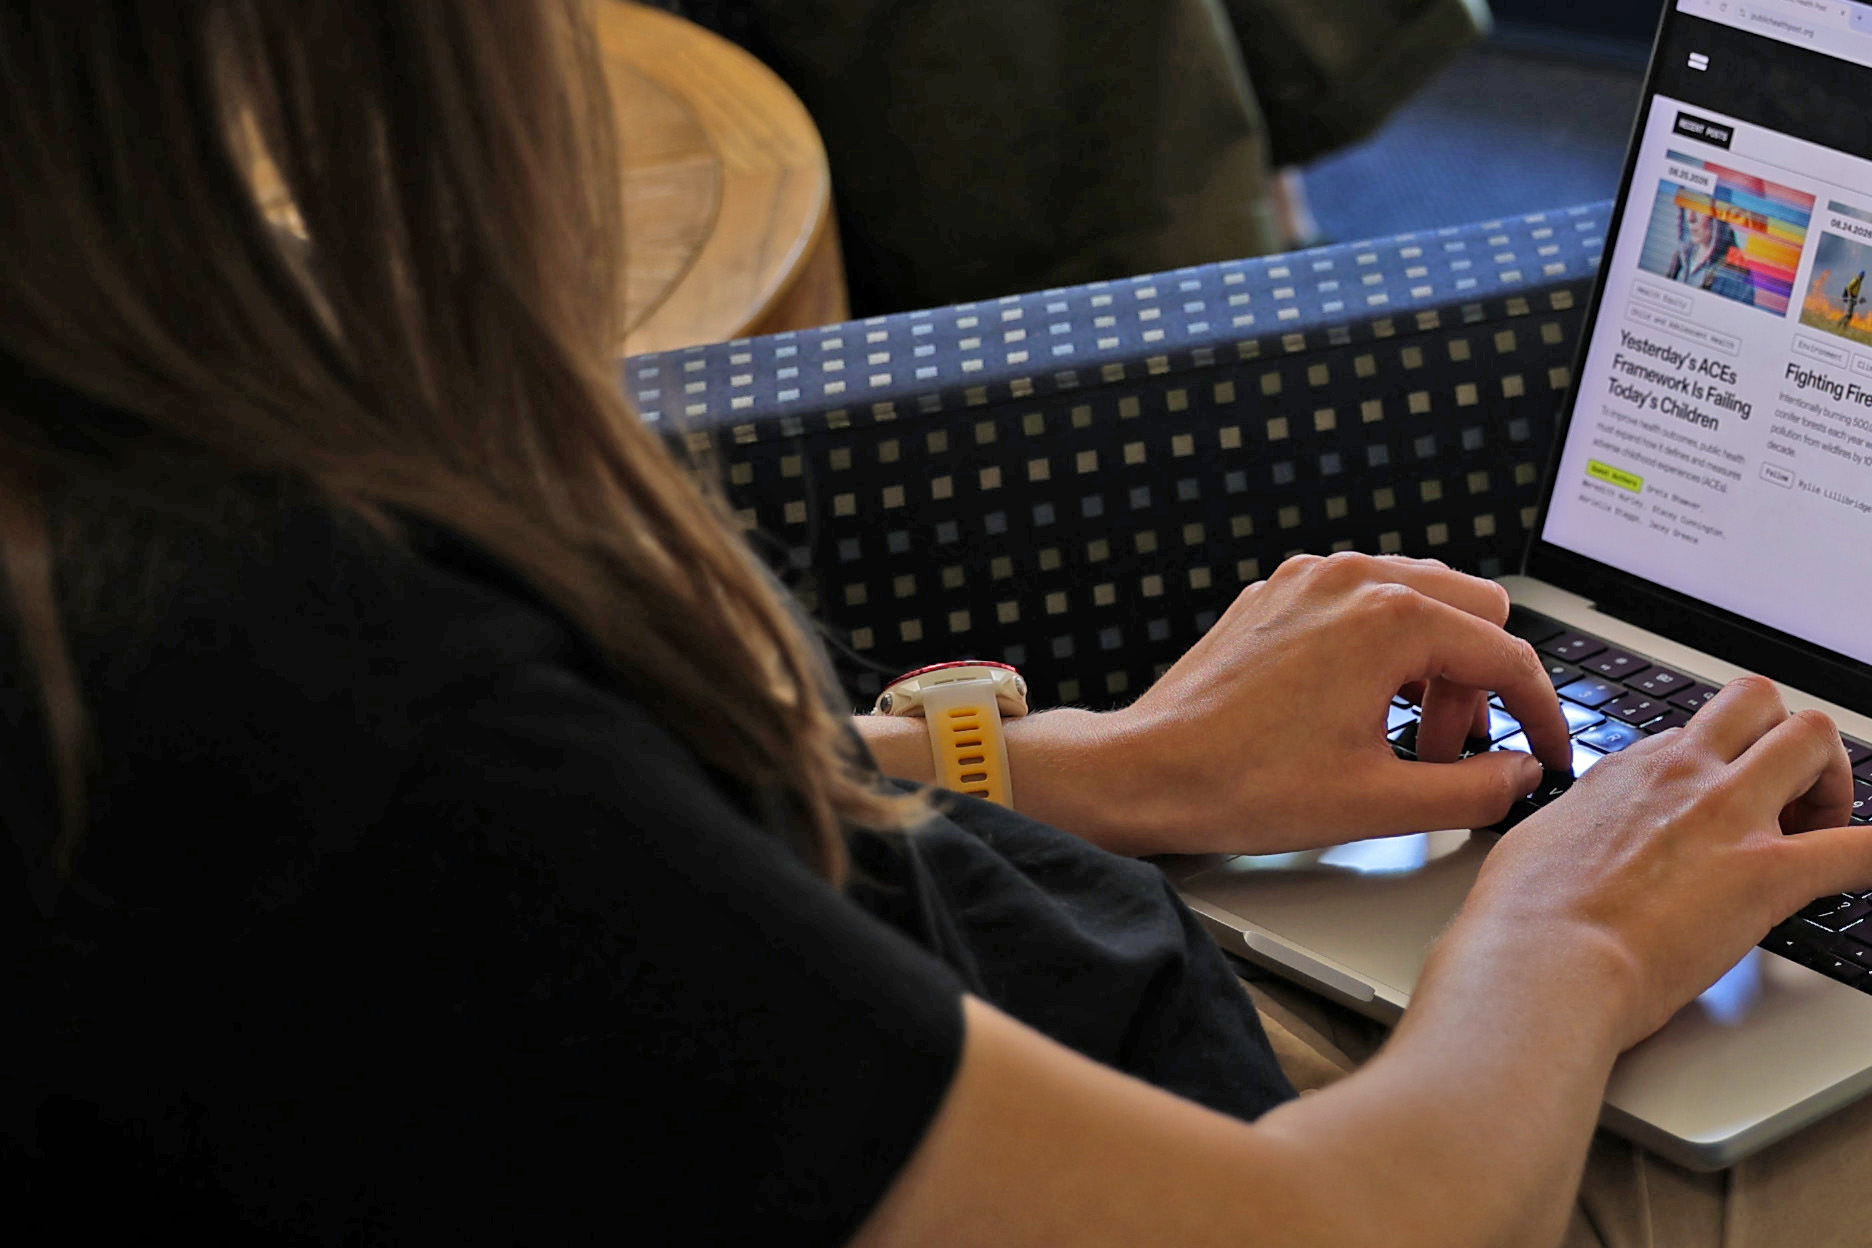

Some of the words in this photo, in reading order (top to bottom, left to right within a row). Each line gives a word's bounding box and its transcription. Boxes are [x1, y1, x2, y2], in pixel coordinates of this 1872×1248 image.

[1830, 218, 1872, 239] 08.24.2026
[1612, 353, 1689, 394] Framework
[1690, 380, 1704, 399] Is
[1705, 385, 1751, 420] Failing
[1697, 358, 1736, 384] ACEs
[1785, 362, 1844, 401] Fighting
[1660, 396, 1718, 430] Children
[1822, 406, 1852, 426] burning
[1769, 424, 1802, 441] pollution
[1802, 434, 1821, 448] from
[1851, 451, 1862, 465] by
[1801, 416, 1826, 433] forests
[1827, 427, 1846, 440] each
[1846, 434, 1864, 446] year
